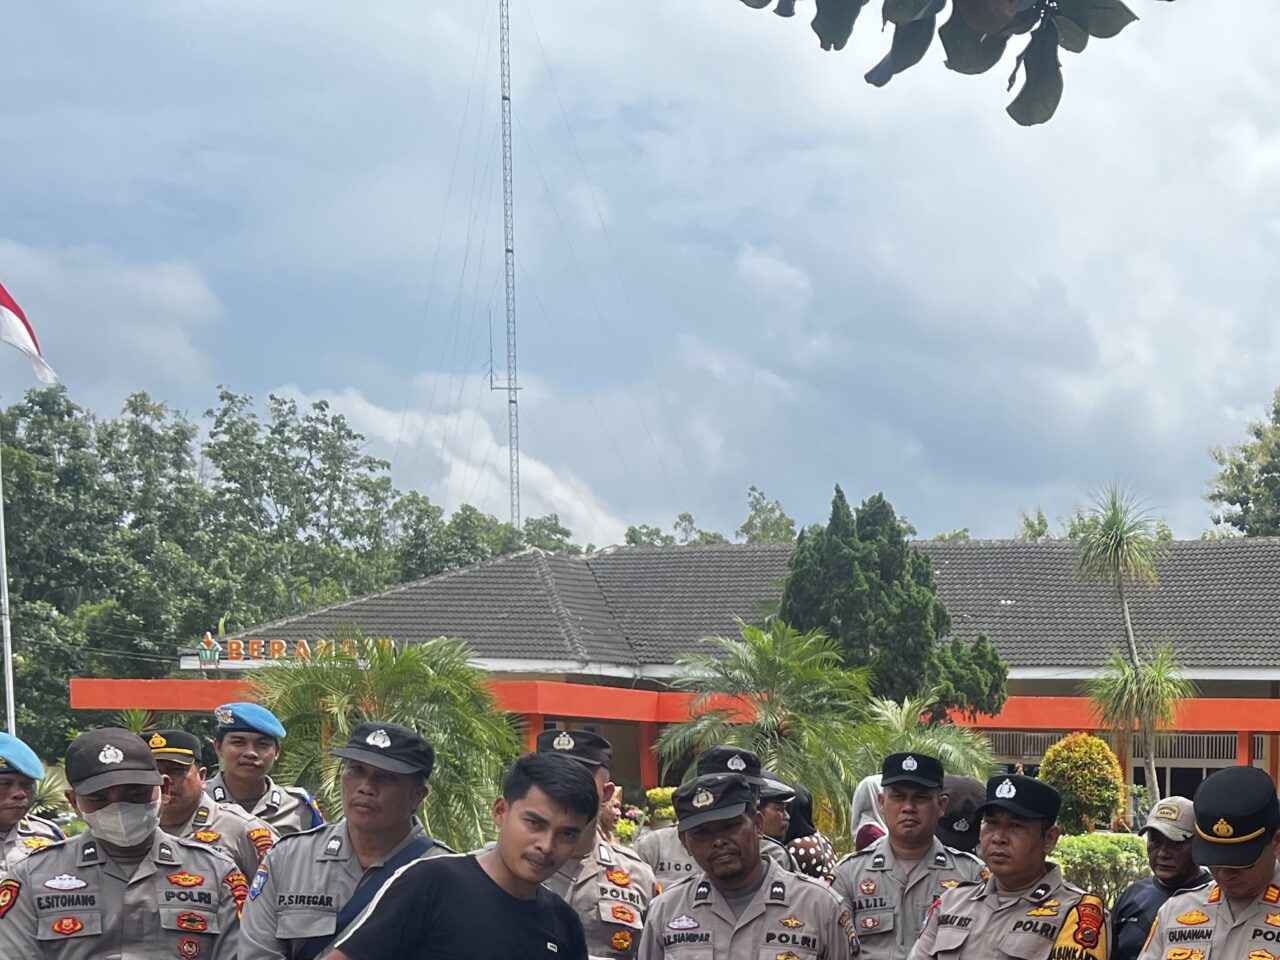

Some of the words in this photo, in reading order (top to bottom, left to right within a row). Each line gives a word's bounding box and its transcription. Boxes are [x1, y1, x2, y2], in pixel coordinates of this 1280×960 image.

[227, 638, 397, 662] BERANG
[165, 891, 212, 905] POLRI
[278, 894, 334, 907] P.SIREGAR
[600, 887, 641, 904] POLRI
[1012, 919, 1058, 938] POLRI
[1168, 929, 1213, 943] GUNAWAN
[766, 932, 817, 949] POLRI
